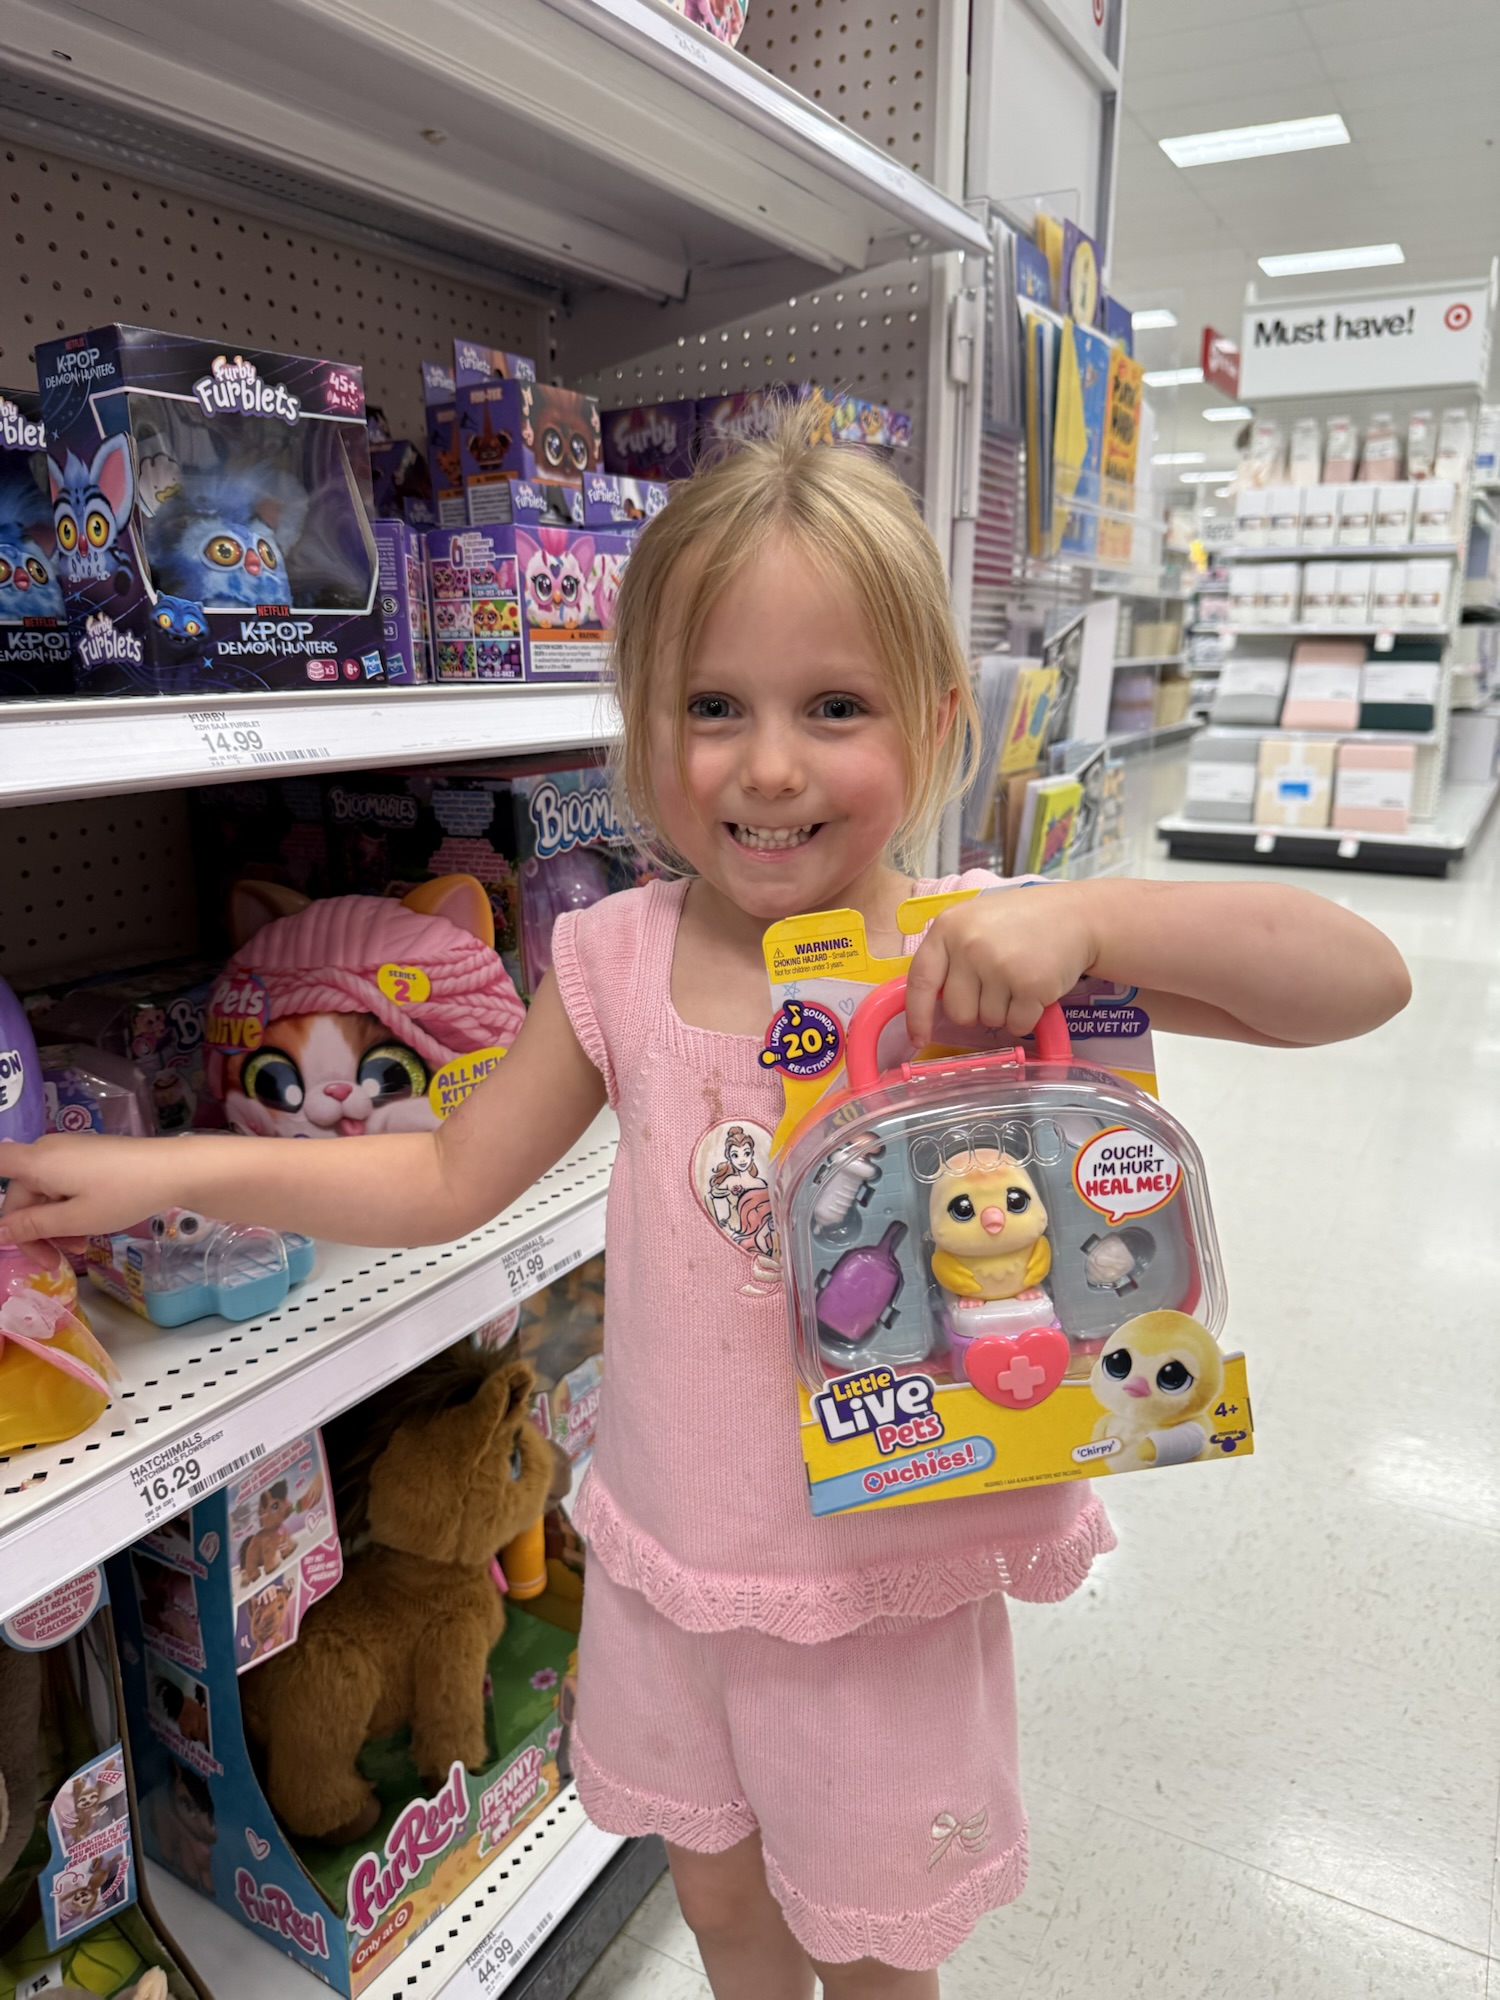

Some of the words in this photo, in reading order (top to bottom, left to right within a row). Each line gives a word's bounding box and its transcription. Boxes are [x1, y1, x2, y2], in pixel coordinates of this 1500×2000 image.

[1255, 317, 1326, 347] Must
[1333, 307, 1416, 342] have!
[45, 368, 79, 389] DEMON
[82, 362, 116, 382] HUNTERS
[212, 355, 256, 385] Furby
[329, 371, 358, 394] 45+
[195, 378, 299, 421] Furblets
[613, 414, 677, 457] Furby
[24, 617, 57, 628] NETFLIX
[257, 605, 290, 617] NETFLIX
[79, 634, 142, 666] Furblets
[217, 639, 277, 656] DEMON
[282, 641, 338, 657] HUNTERS
[347, 663, 358, 675] 6+
[188, 712, 227, 723] FURBY
[201, 730, 263, 753] 14.99
[795, 937, 853, 955] WARNING:
[773, 957, 801, 968] CHOKING
[802, 953, 828, 964] HAZARD
[775, 969, 784, 977] Not
[792, 966, 811, 974] children
[812, 964, 825, 972] under
[388, 969, 417, 980] SERIES
[211, 980, 265, 1015] Pets
[394, 979, 411, 1002] 2
[803, 1008, 835, 1032] SOUNDS
[1066, 1009, 1091, 1019] HEAL
[1092, 1009, 1108, 1019] ME
[1109, 1010, 1134, 1019] WITH
[771, 1016, 788, 1046] LIGHTS
[1097, 1021, 1120, 1033] VET
[1121, 1022, 1141, 1033] KIT
[787, 1050, 836, 1075] REACTIONS
[438, 1069, 471, 1089] ALL
[442, 1082, 479, 1105] KITT
[1101, 1144, 1153, 1160] OUCH!
[1093, 1162, 1115, 1177] I'M
[1120, 1159, 1164, 1175] HURT
[1085, 1177, 1133, 1197] HEAL
[1137, 1173, 1172, 1193] ME!
[501, 1235, 545, 1265] HATCHIMALS
[507, 1254, 544, 1288] 21.99
[833, 1372, 891, 1402] Little
[1214, 1402, 1238, 1417] 4+
[130, 1432, 203, 1480] HATCHIMALS
[133, 1456, 181, 1487] HATCHIMALS
[180, 1430, 224, 1461] FLOWERFEST
[864, 1444, 975, 1493] Ouchies!
[140, 1458, 201, 1507] 16.29
[54, 1569, 97, 1597] REACTIONS
[16, 1611, 38, 1628] SONS
[40, 1605, 50, 1616] ET
[35, 1609, 84, 1639] REACCIONES
[37, 1604, 72, 1628] SONIDOS
[73, 1600, 79, 1609] Y
[483, 1752, 535, 1818] PENNY
[68, 1832, 106, 1856] INTERACTIVE
[356, 1935, 381, 1963] Only
[382, 1923, 394, 1940] at
[466, 1930, 498, 1966] FURREAL
[478, 1937, 514, 1984] 44.99
